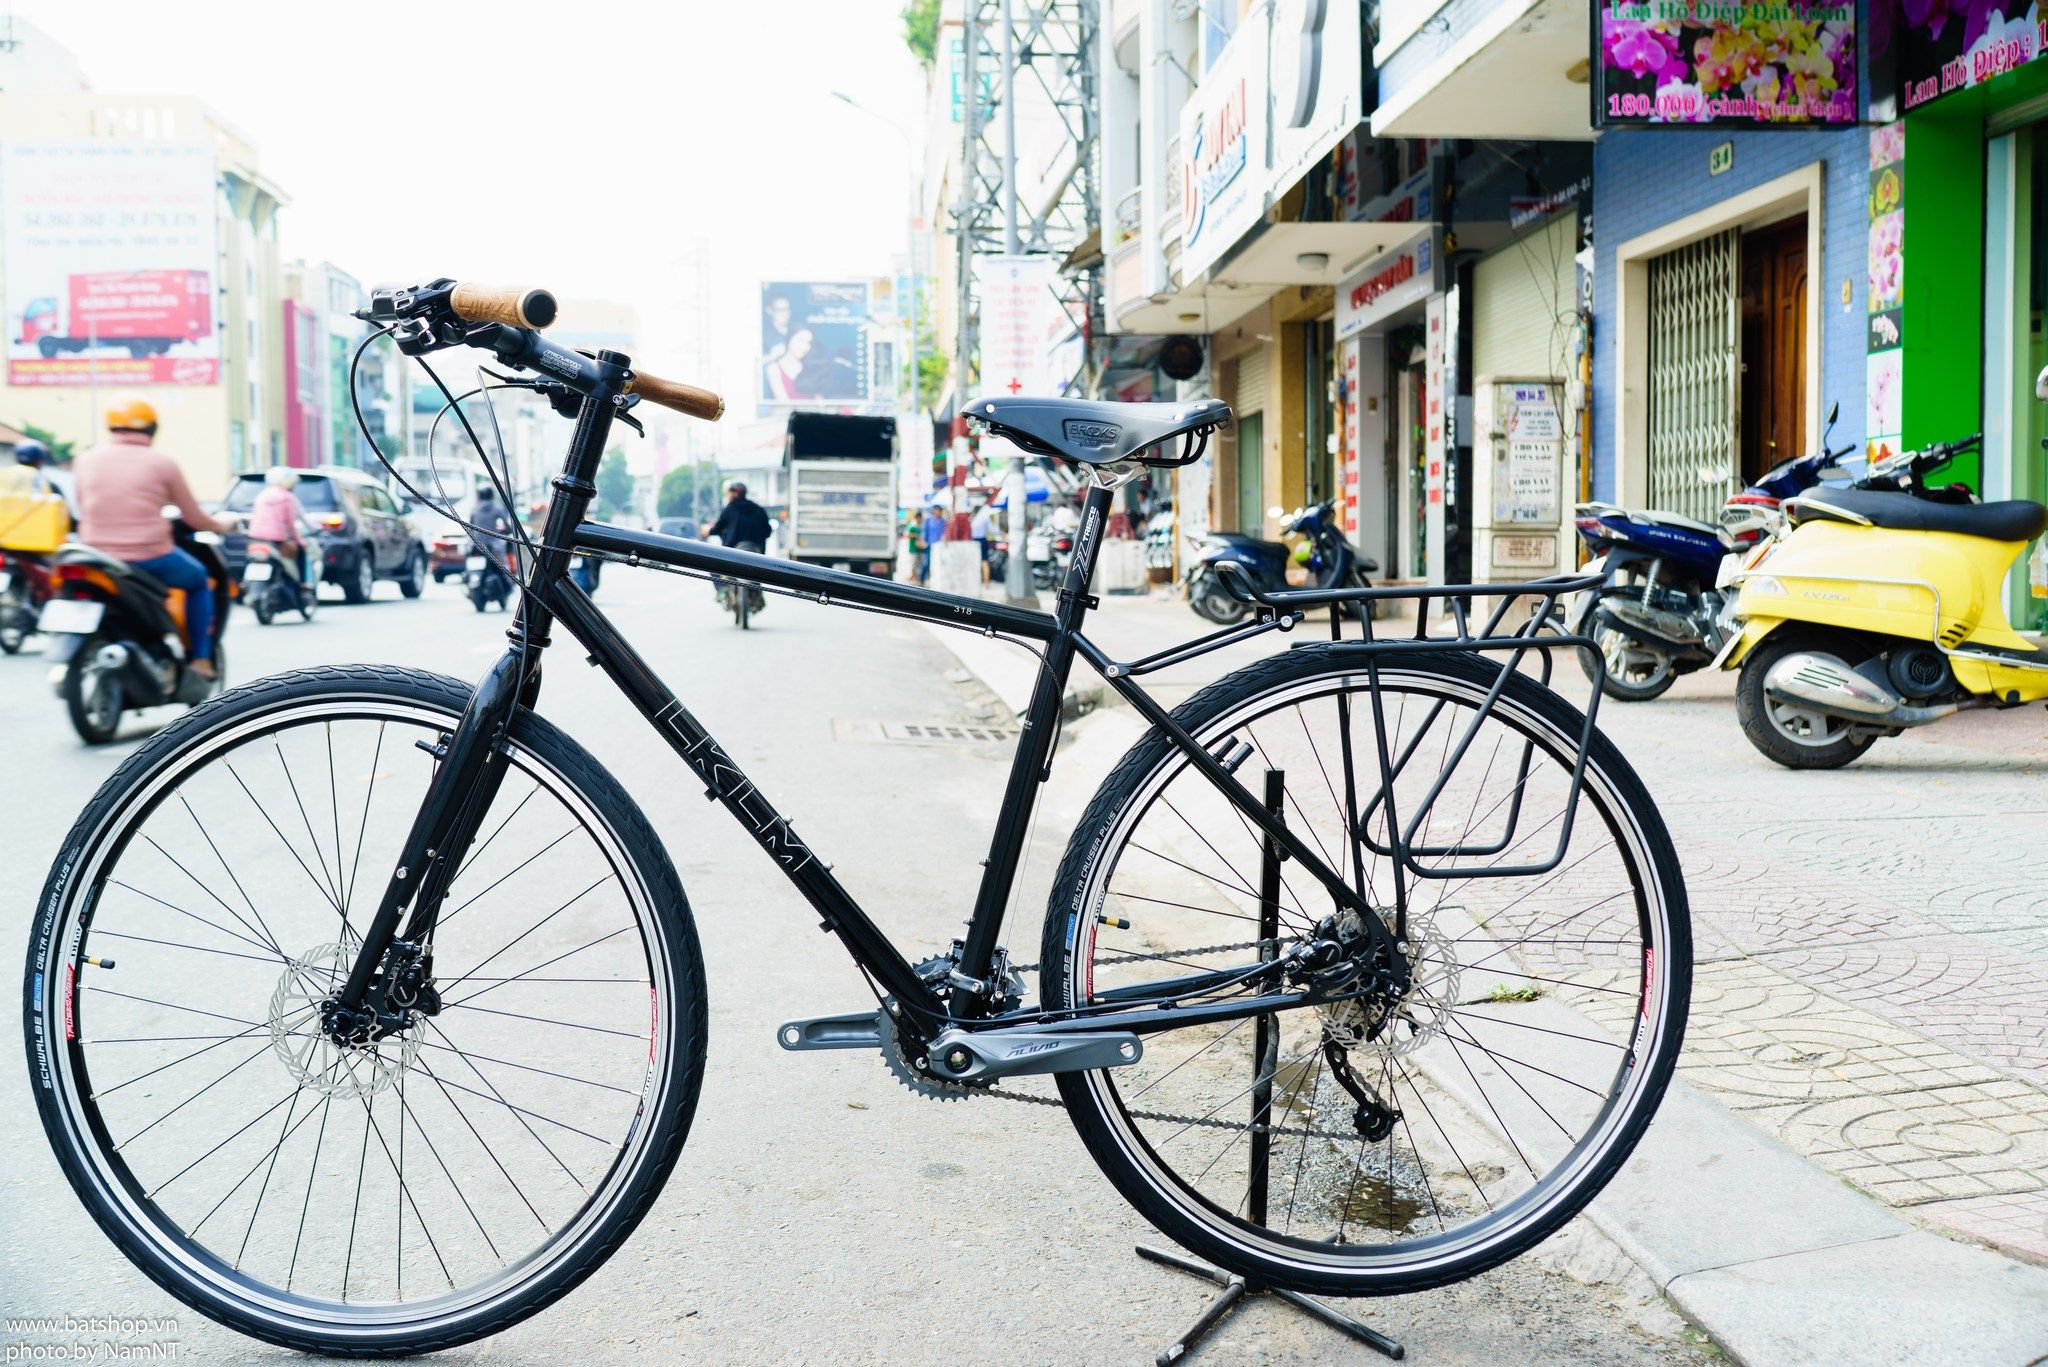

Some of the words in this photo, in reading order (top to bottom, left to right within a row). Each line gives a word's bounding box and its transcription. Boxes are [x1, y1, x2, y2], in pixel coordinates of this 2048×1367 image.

[1612, 0, 1651, 20] Lan
[1905, 75, 1938, 109] Lan
[1941, 55, 1967, 93] Hồ
[1974, 40, 2019, 79] Điệp
[1712, 147, 1729, 170] 34
[1069, 424, 1118, 439] BROOKS
[953, 604, 973, 616] 318
[1072, 878, 1085, 911] DELTA
[1080, 838, 1102, 878] CRUISER
[1100, 811, 1116, 838] PLUS
[55, 862, 71, 892] PLUS
[43, 890, 59, 936] CRUISER
[35, 940, 48, 970] DELTA
[33, 1016, 51, 1090] SCHWALBE
